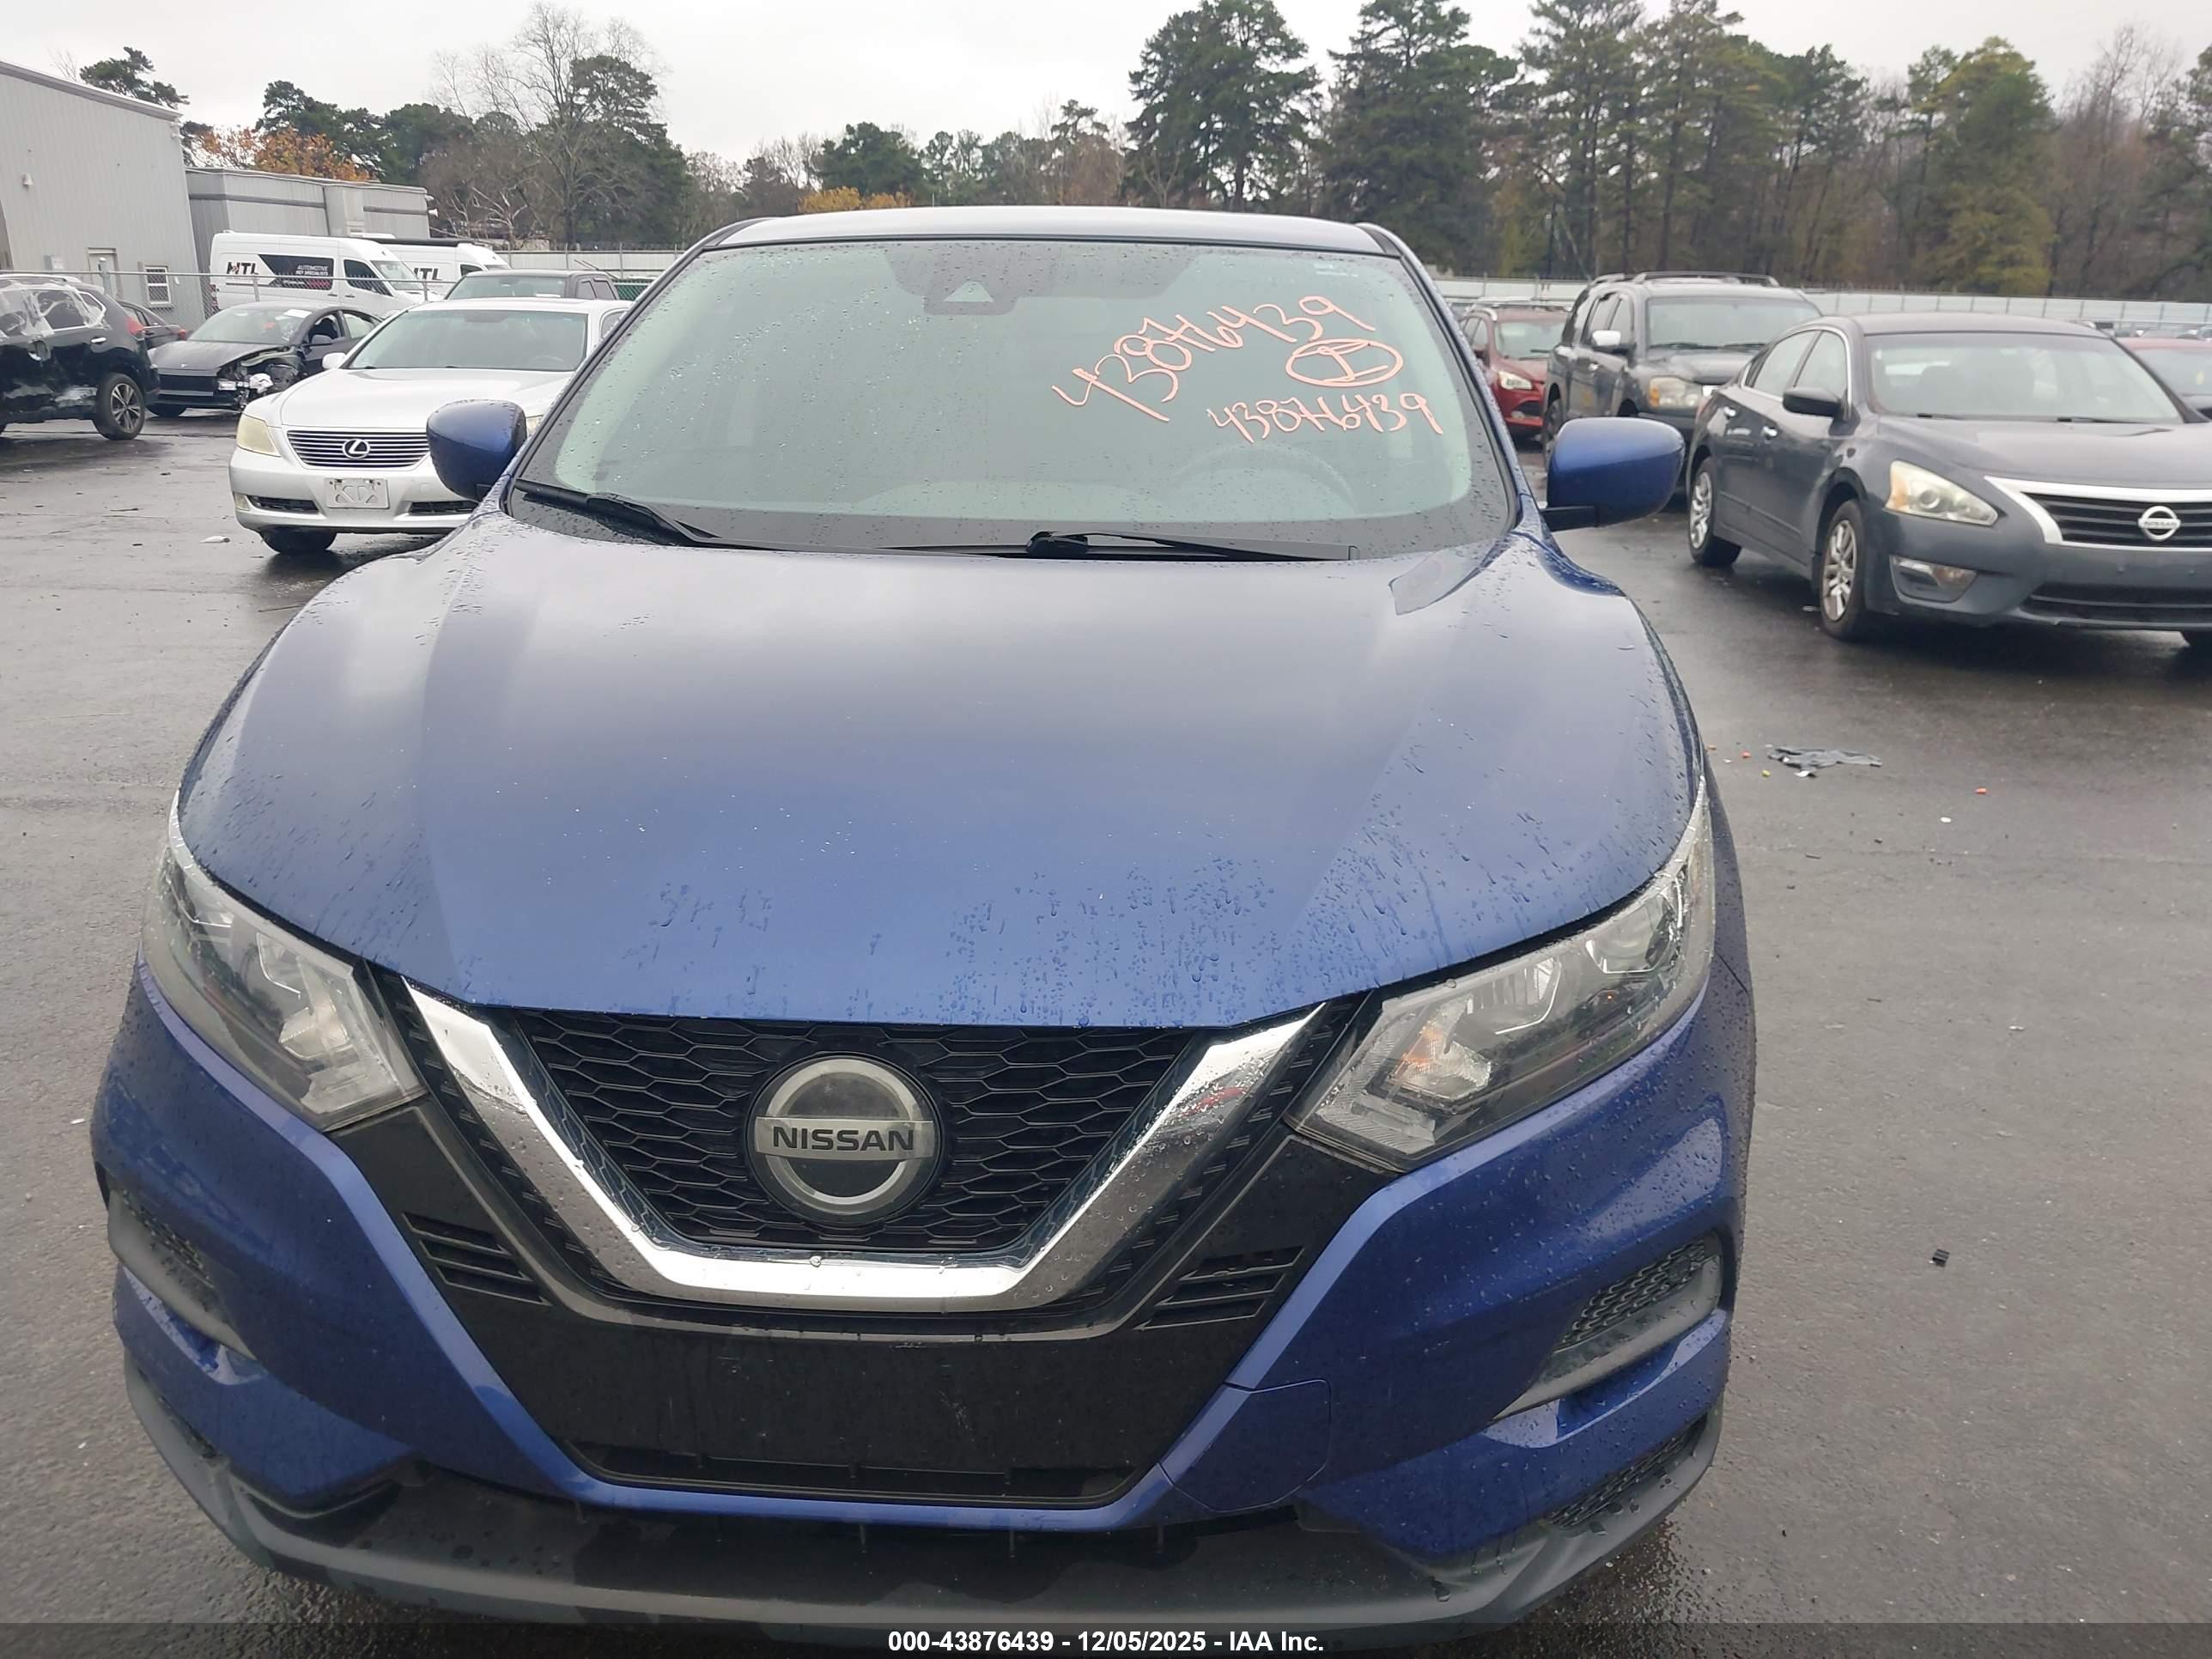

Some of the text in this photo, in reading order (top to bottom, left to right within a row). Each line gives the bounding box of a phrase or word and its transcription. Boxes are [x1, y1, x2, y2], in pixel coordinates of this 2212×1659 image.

[1052, 295, 1376, 422] 43876439
[1206, 392, 1443, 444] 43876439
[773, 1126, 914, 1152] NISSAN
